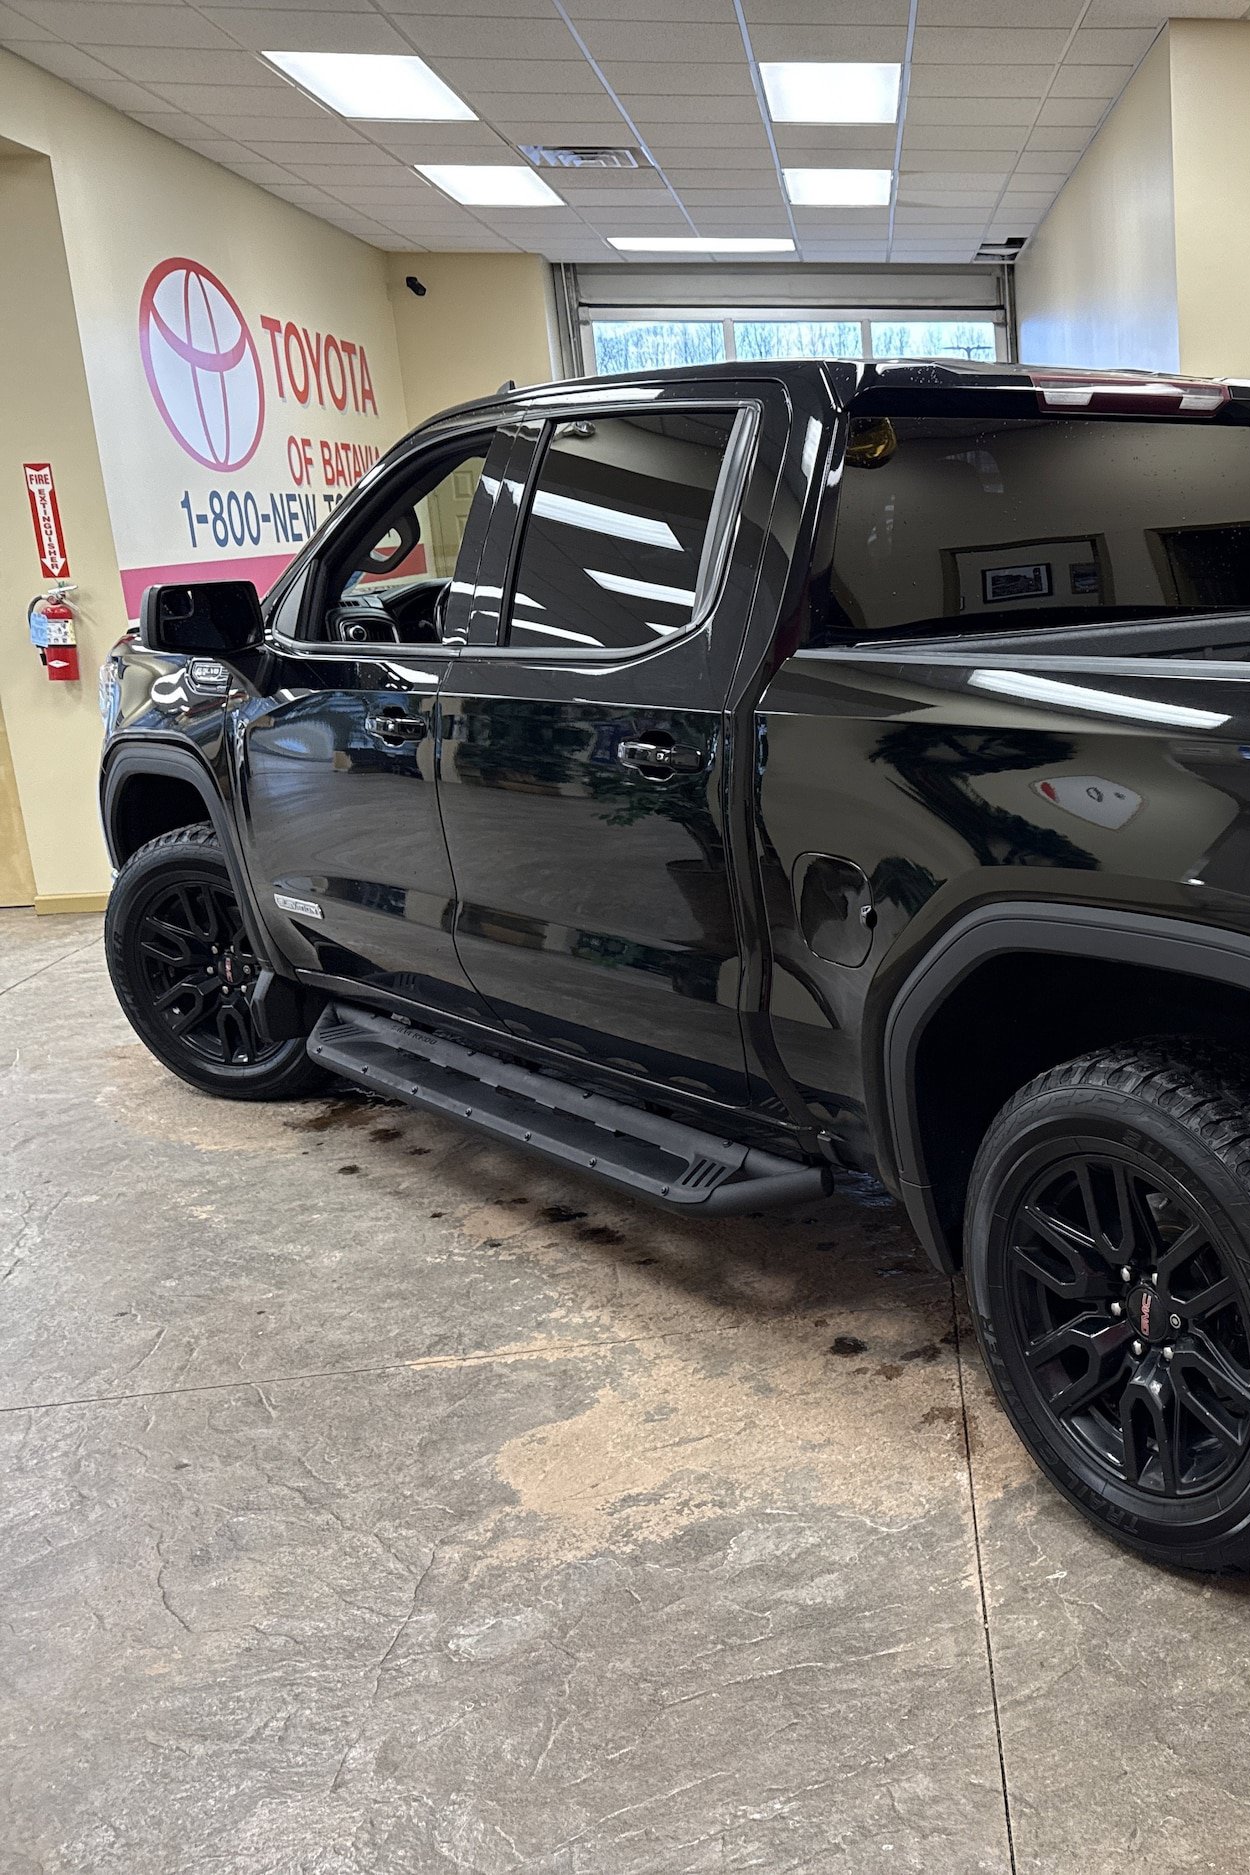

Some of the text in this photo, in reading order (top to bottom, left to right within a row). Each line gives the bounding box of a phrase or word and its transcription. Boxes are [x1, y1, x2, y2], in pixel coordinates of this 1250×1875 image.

[260, 314, 378, 416] TOYOTA
[29, 474, 50, 485] FIRE
[287, 435, 313, 487] OF
[38, 489, 60, 570] EXTINGUISHER
[181, 490, 317, 548] 1-800-NEW
[1141, 1292, 1152, 1336] GMC
